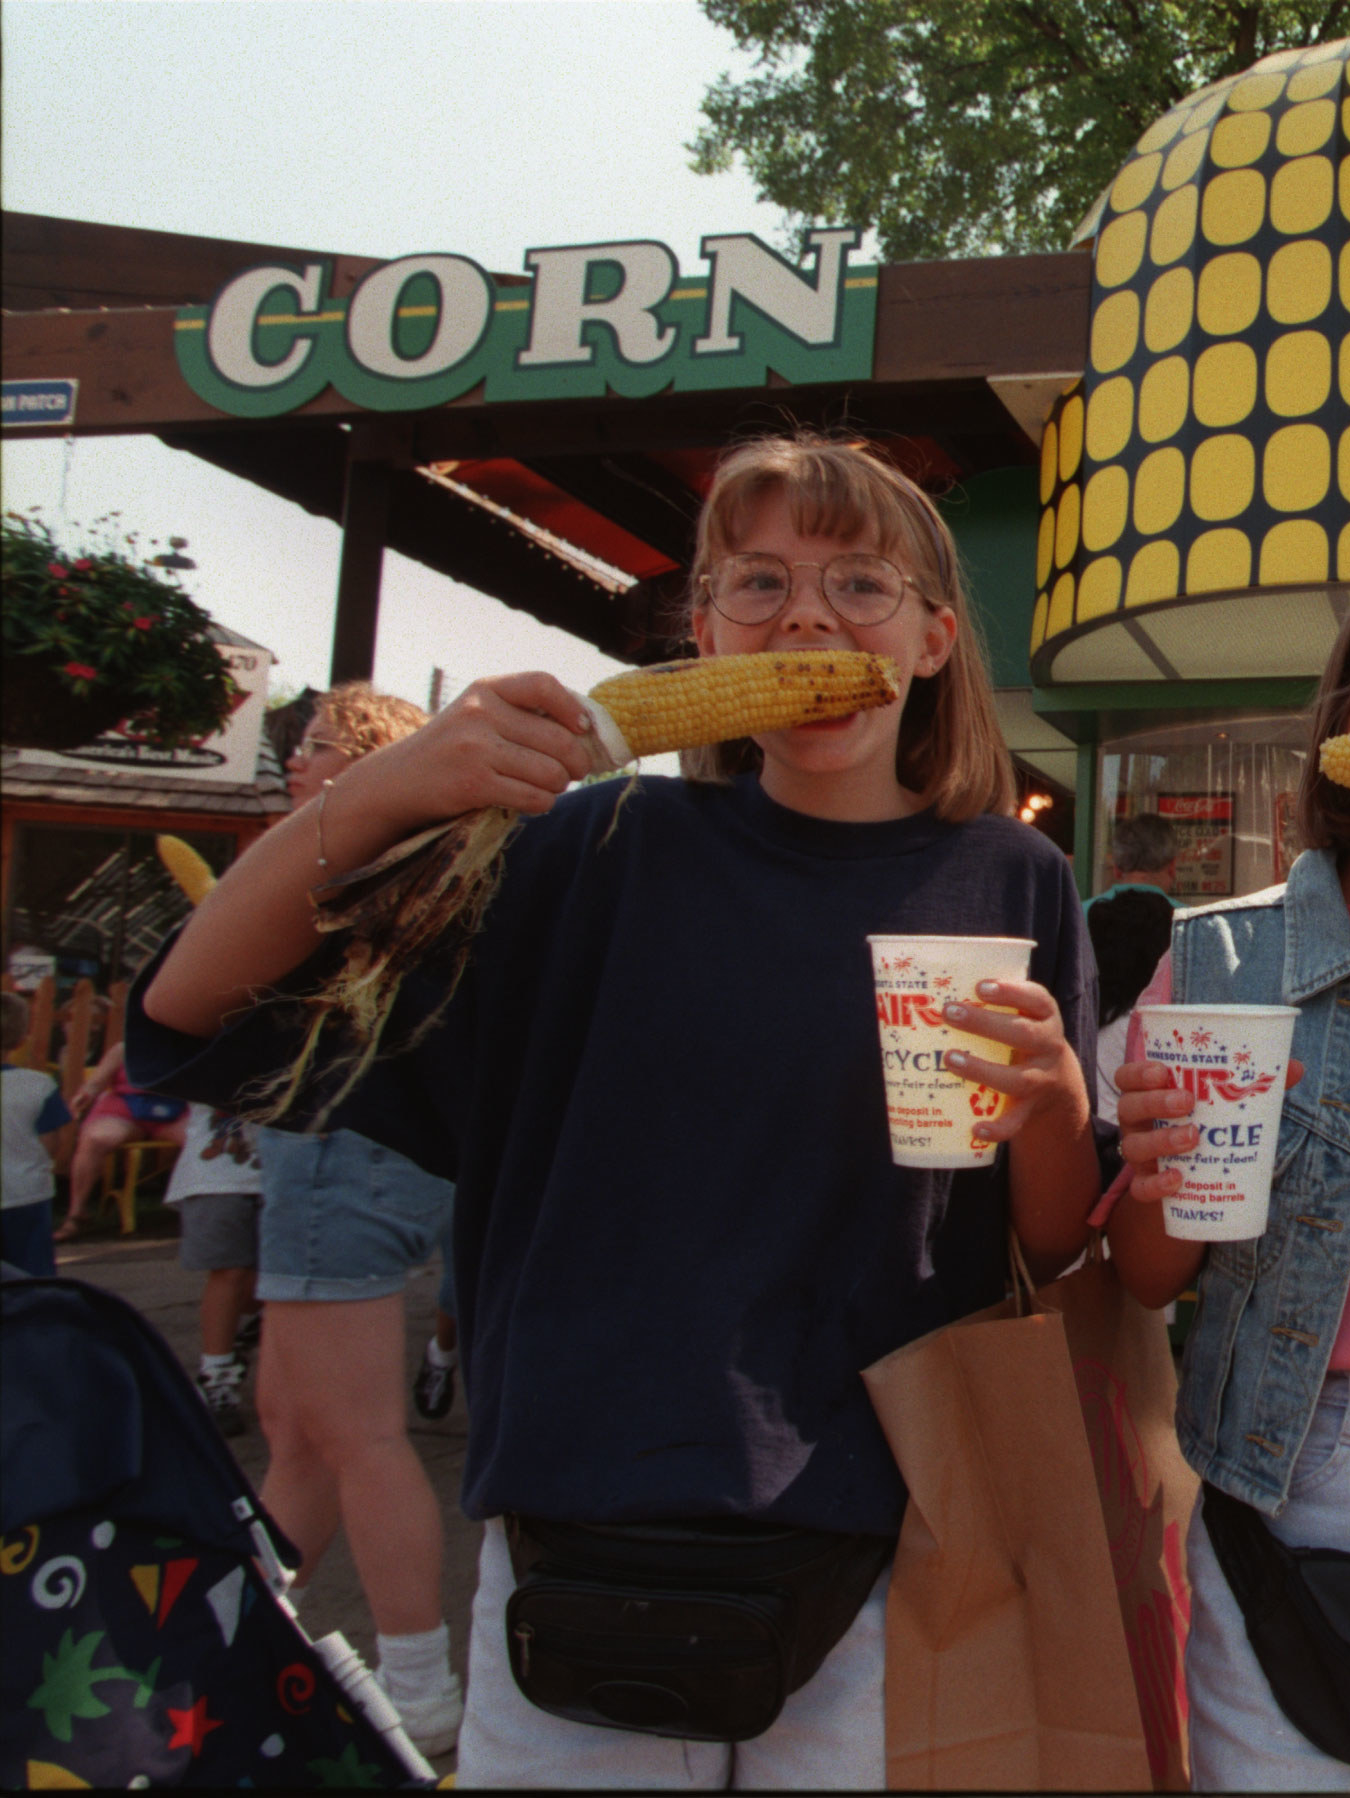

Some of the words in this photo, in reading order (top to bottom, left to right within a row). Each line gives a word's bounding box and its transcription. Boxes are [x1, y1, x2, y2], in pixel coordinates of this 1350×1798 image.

[207, 229, 857, 387] CORN
[19, 393, 68, 411] PATCH
[896, 980, 928, 989] STATE
[876, 992, 943, 1028] AIR
[882, 1049, 965, 1072] CYCL
[1191, 1054, 1229, 1065] STATE
[903, 1078, 925, 1089] fair
[927, 1077, 966, 1090] clean!
[897, 1107, 929, 1117] deposit
[932, 1107, 943, 1116] in
[916, 1119, 953, 1129] barrels
[1194, 1152, 1221, 1164] fair
[1223, 1151, 1258, 1165] clean!
[1184, 1180, 1223, 1191] deposit
[1226, 1182, 1236, 1190] in
[1209, 1193, 1245, 1203] barrels
[1170, 1206, 1224, 1222] THANKS!
